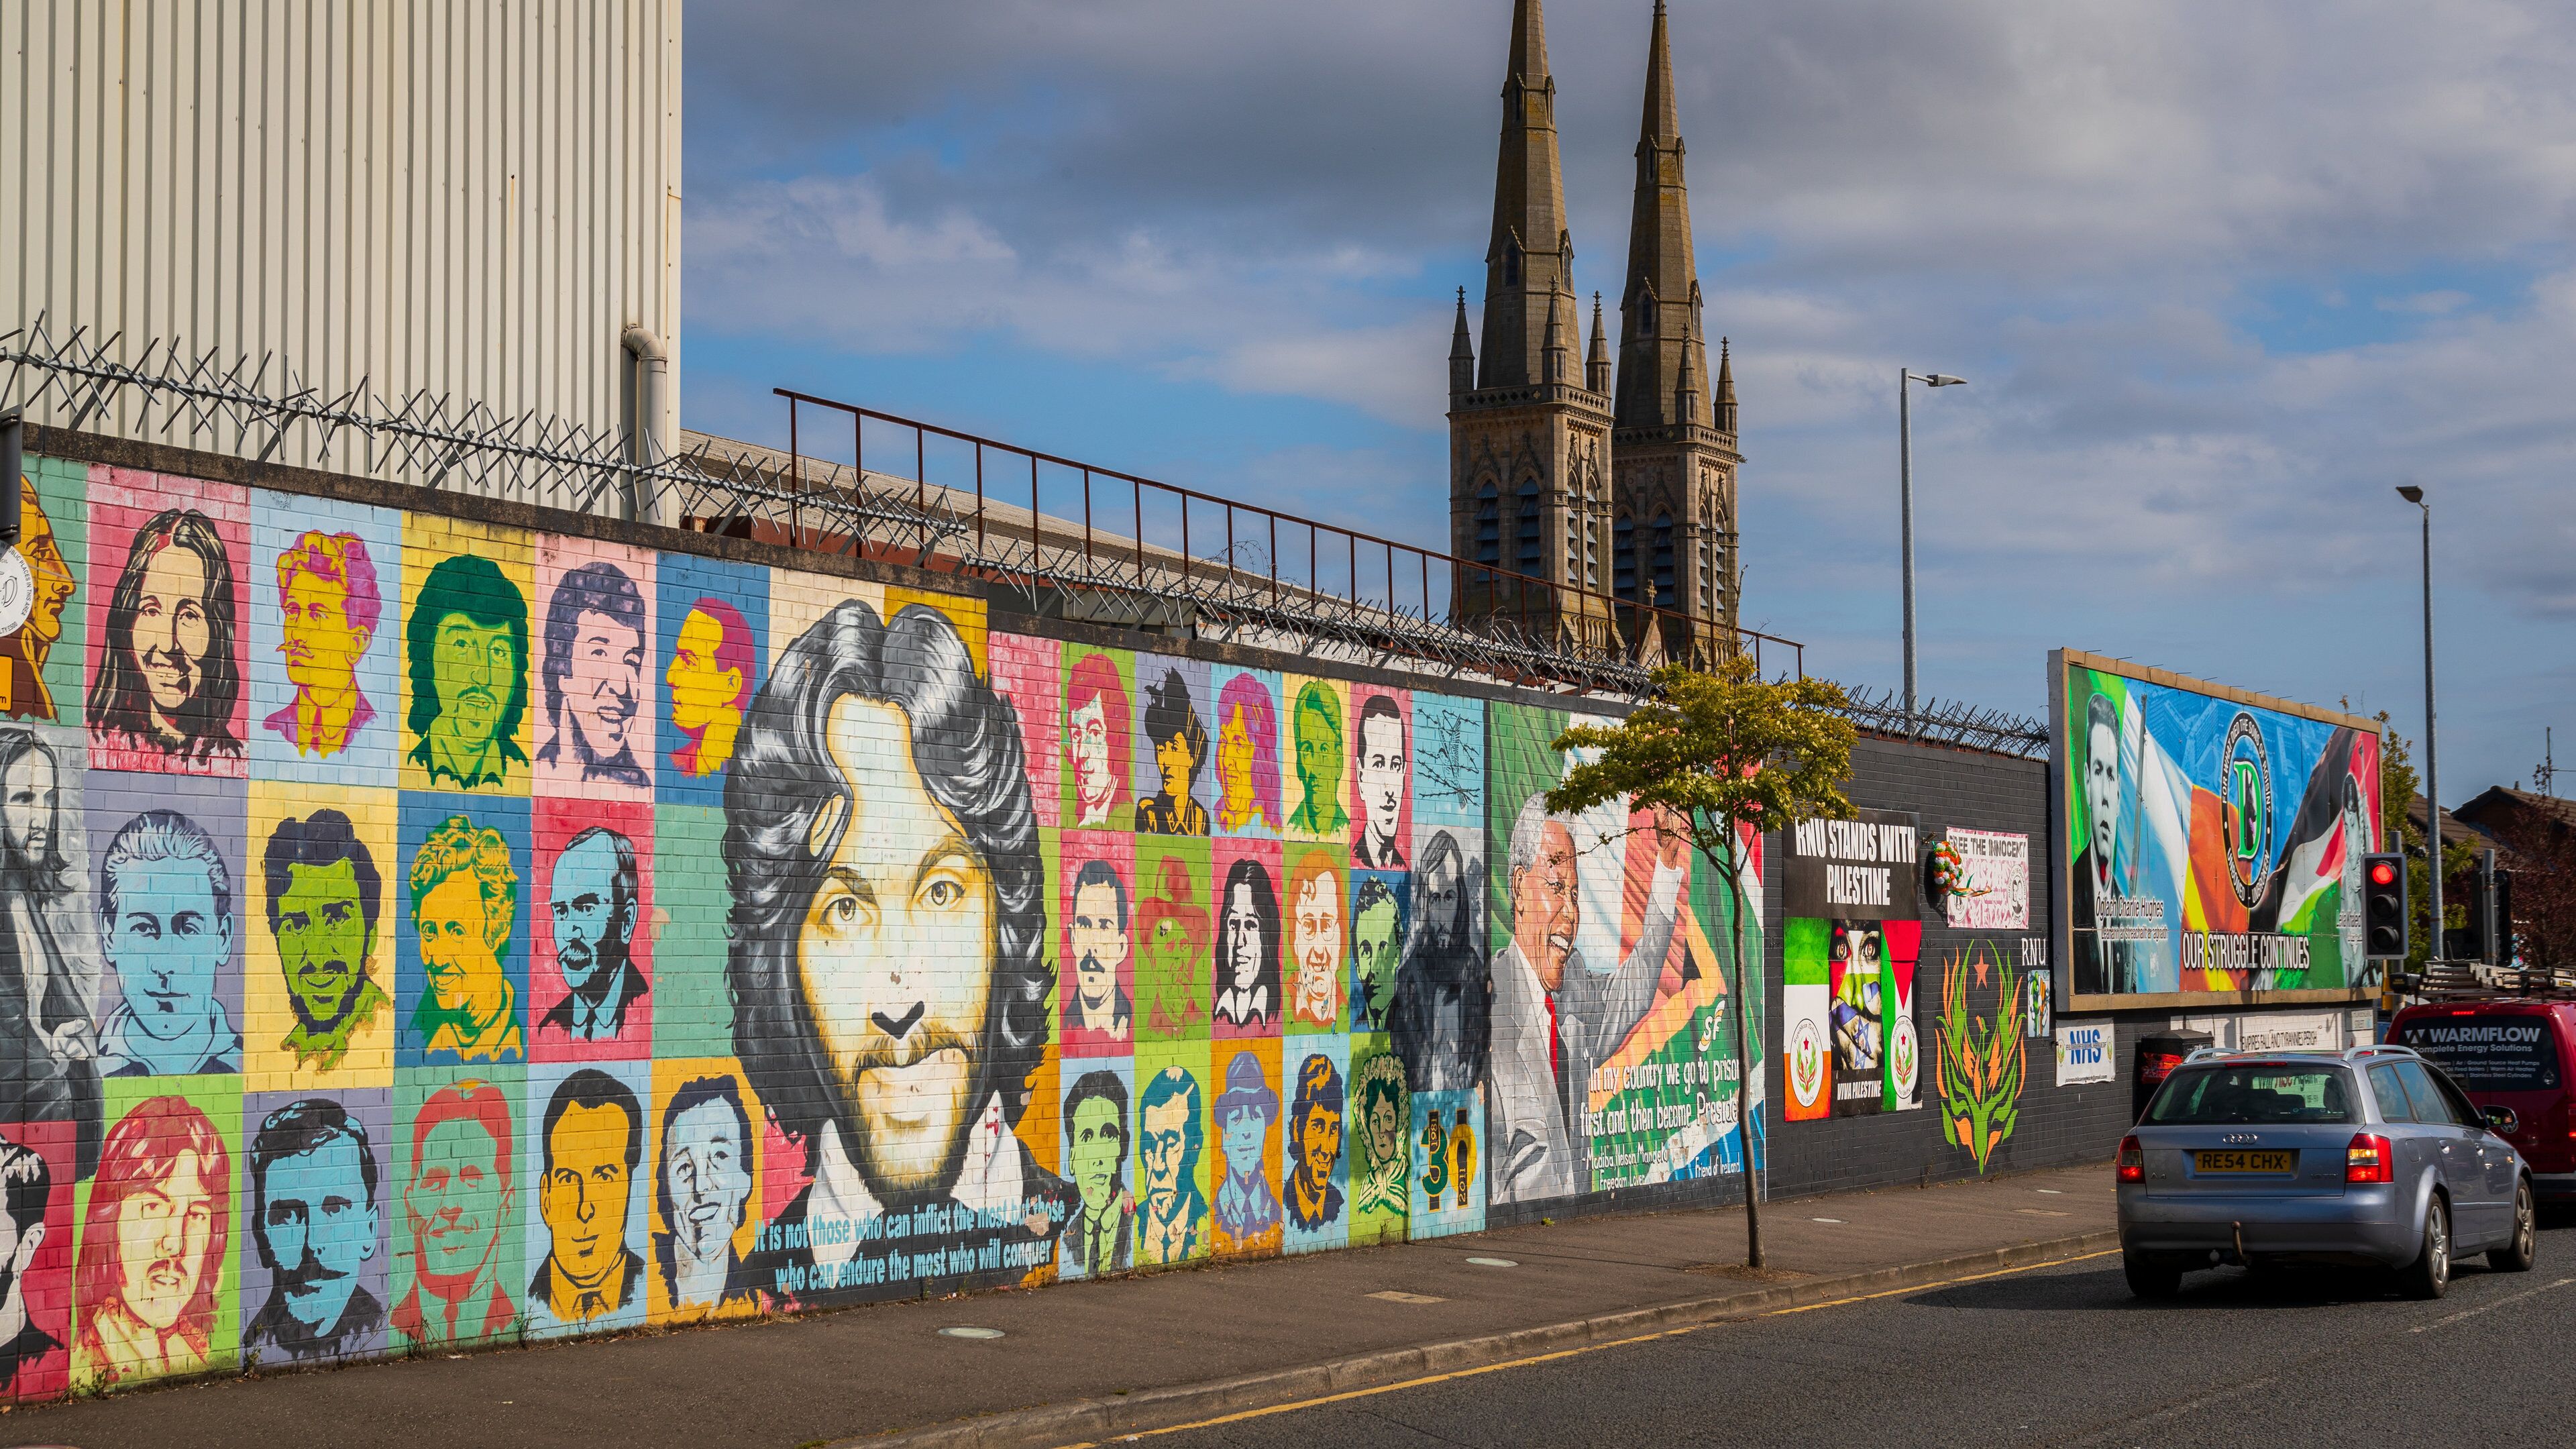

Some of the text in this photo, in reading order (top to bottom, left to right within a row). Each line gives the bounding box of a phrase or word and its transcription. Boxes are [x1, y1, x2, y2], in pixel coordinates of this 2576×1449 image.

[19, 559, 31, 582] PLACES
[2224, 738, 2233, 773] WHAT
[2231, 721, 2240, 741] DIED
[2239, 718, 2248, 731] THE
[2249, 721, 2260, 746] SONS
[1794, 816, 1916, 863] RNU STANDS WITH
[1971, 837, 1986, 856] THE
[1988, 838, 2026, 858] INNOCENT
[1827, 864, 1890, 906] PALESTINE
[2227, 847, 2269, 903] UNBOWED UNBROKEN
[2118, 896, 2139, 917] Charlie
[2141, 896, 2163, 921] Hughes
[2021, 937, 2047, 966] RNU
[2182, 932, 2310, 969] OUR STRUGGLE CONTINUES
[2070, 1028, 2102, 1065] NHS
[2412, 1044, 2533, 1054] Complete Energy Solutions
[2429, 1027, 2541, 1042] WARMFLOW
[1603, 1067, 1619, 1095] my
[1623, 1059, 1663, 1092] country
[1684, 1061, 1695, 1095] go
[1698, 1056, 1709, 1085] to
[1837, 1080, 1882, 1100] VIVA PALESTINE
[1580, 1102, 1605, 1136] first
[1607, 1099, 1626, 1134] and
[1630, 1098, 1654, 1132] then
[1656, 1097, 1692, 1129] become
[1615, 1142, 1637, 1166] Nelson
[1637, 1140, 1669, 1164] Mandela
[1695, 1152, 1740, 1179] Friend of Ireland
[2202, 1153, 2283, 1169] RE54 CHX
[1458, 1168, 1466, 1202] 2011
[1599, 1167, 1627, 1191] Freedom
[754, 1219, 766, 1252] It
[769, 1218, 782, 1251] is
[785, 1216, 809, 1249] not
[812, 1214, 851, 1246] those
[854, 1210, 883, 1240] who
[886, 1213, 911, 1239] can
[914, 1203, 951, 1235] inflict
[953, 1201, 975, 1232] the
[977, 1198, 1008, 1229] most
[1011, 1196, 1030, 1226] but
[775, 1238, 1052, 1293] who can endure the most who will conquer
